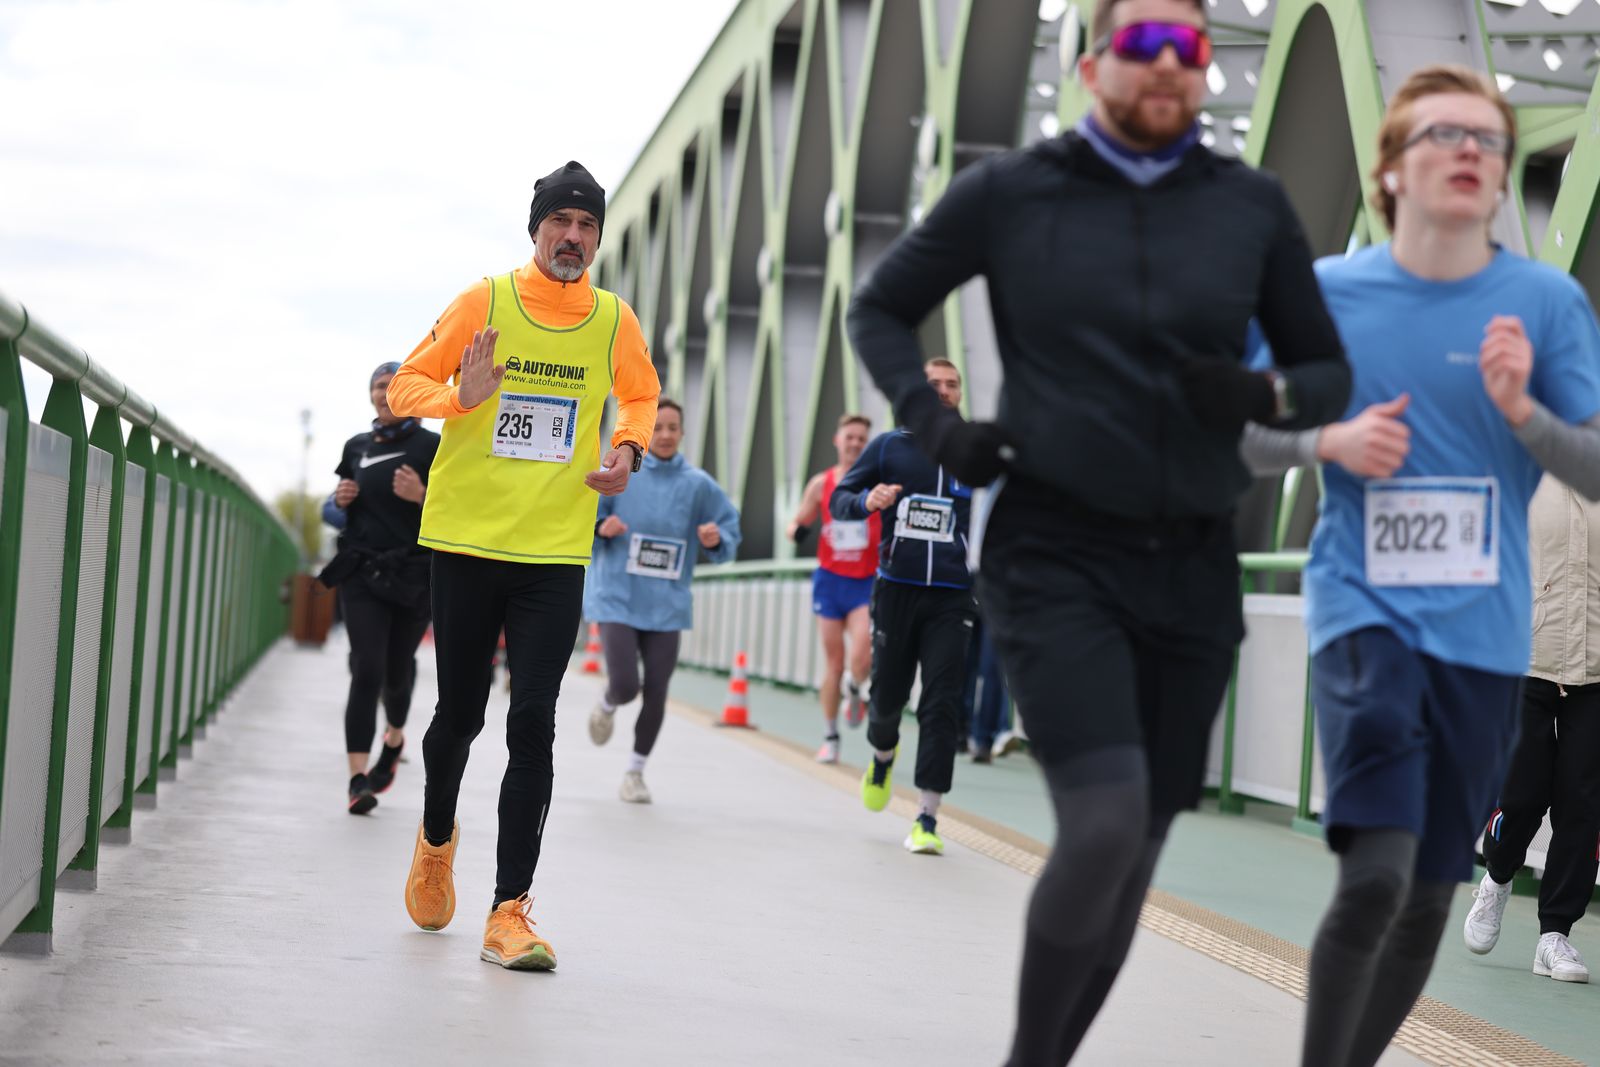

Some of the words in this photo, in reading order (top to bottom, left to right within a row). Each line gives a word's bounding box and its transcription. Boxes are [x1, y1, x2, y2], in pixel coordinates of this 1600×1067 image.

[504, 374, 586, 390] www.autofunia.com
[507, 394, 525, 402] 20th
[525, 395, 569, 407] anniversary
[497, 412, 534, 440] 235
[1373, 513, 1448, 552] 2022
